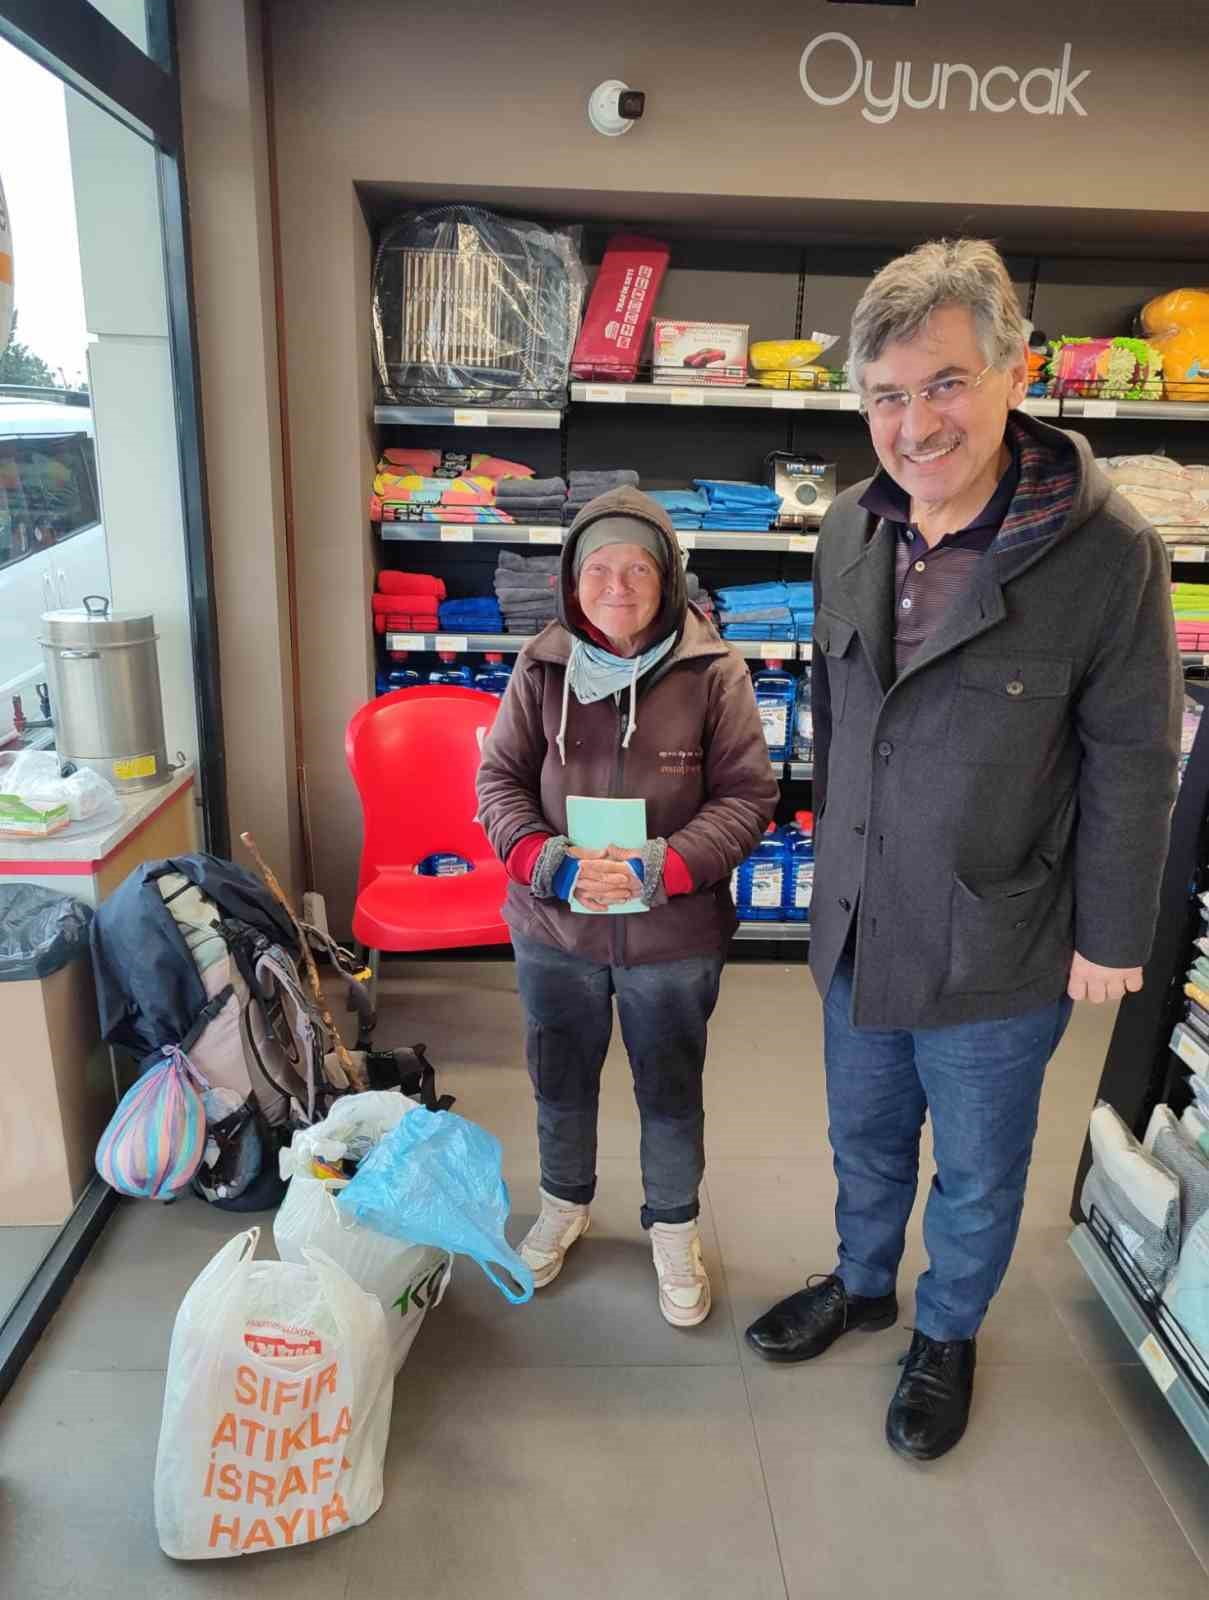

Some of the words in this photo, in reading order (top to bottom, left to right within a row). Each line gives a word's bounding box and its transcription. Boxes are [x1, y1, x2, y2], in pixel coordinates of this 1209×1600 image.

[799, 31, 1092, 124] Oyuncak
[234, 1363, 337, 1416] SIFIR
[208, 1492, 350, 1549] HAYIR
